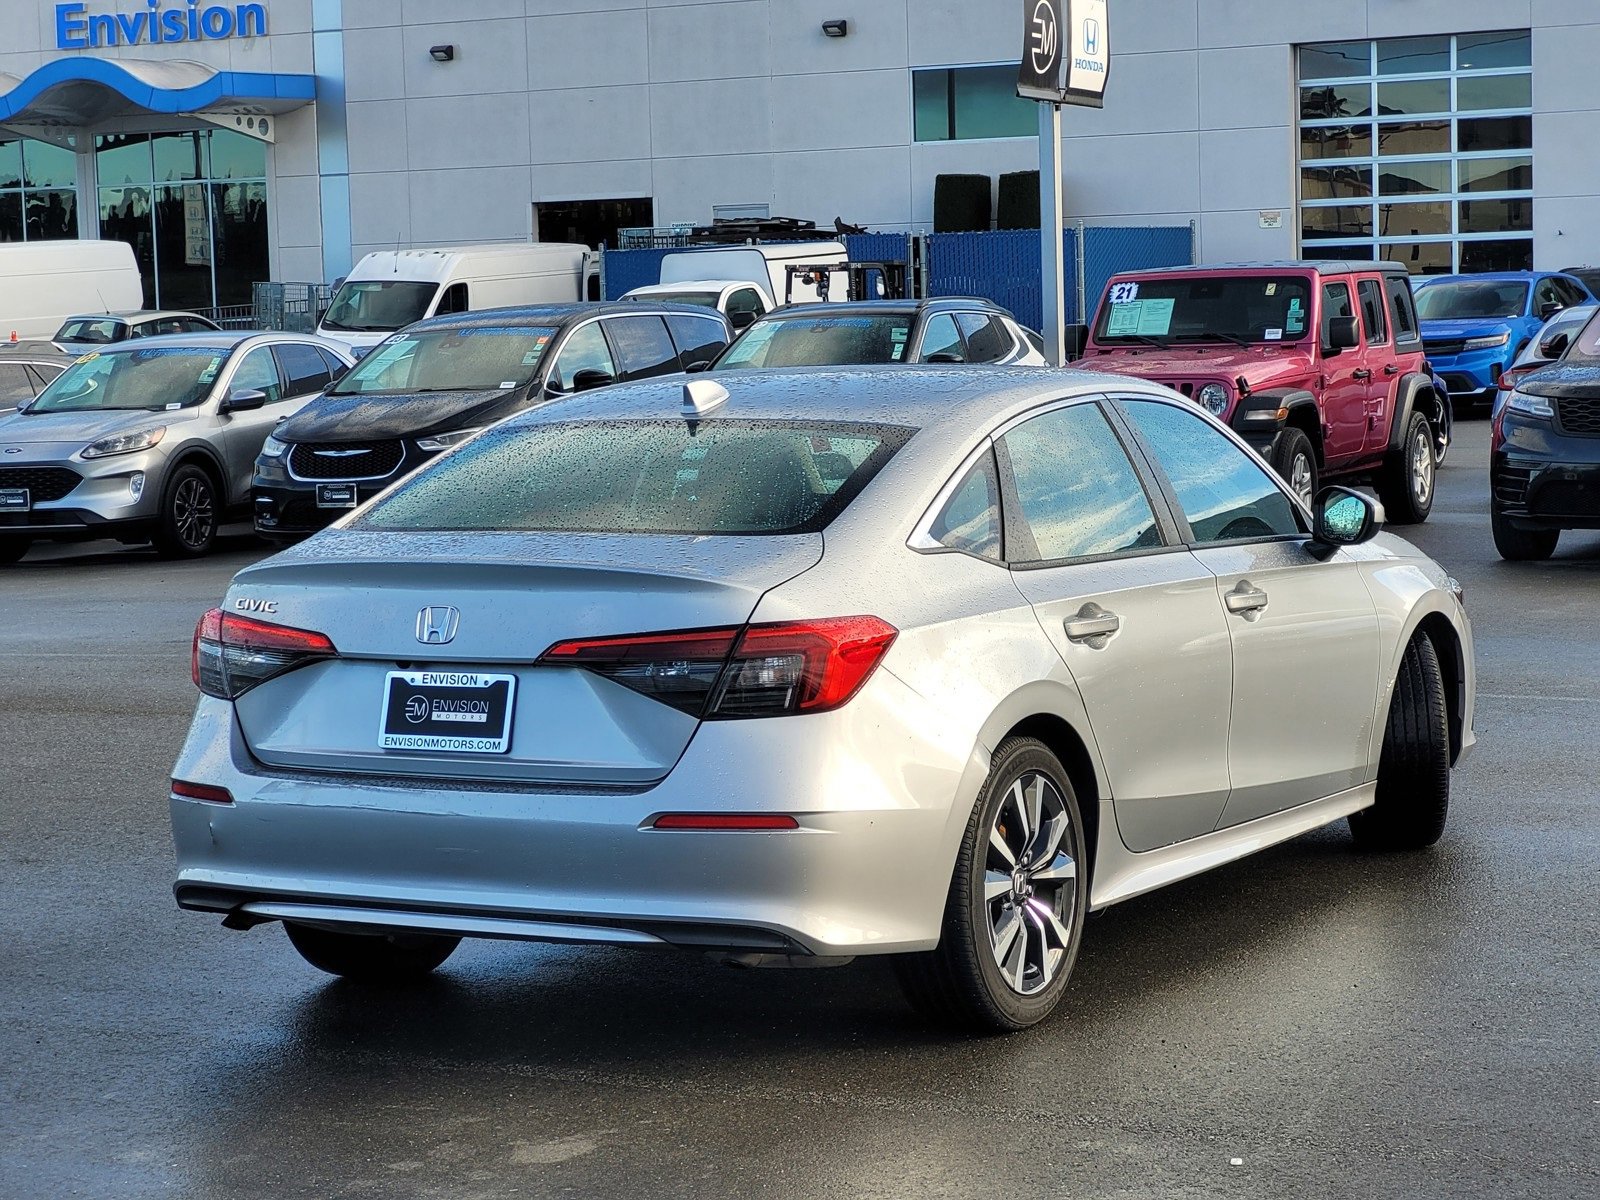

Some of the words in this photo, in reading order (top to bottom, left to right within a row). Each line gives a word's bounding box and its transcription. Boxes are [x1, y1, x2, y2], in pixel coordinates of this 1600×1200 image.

[55, 0, 267, 49] Envision
[1074, 58, 1104, 73] HONDA
[1115, 286, 1132, 300] 21
[235, 598, 279, 613] CIVIC
[421, 673, 479, 686] ENVISION
[431, 698, 490, 713] ENVISION
[435, 712, 484, 721] MOTORS
[383, 736, 502, 751] ENVISIONMOTORS.COM
